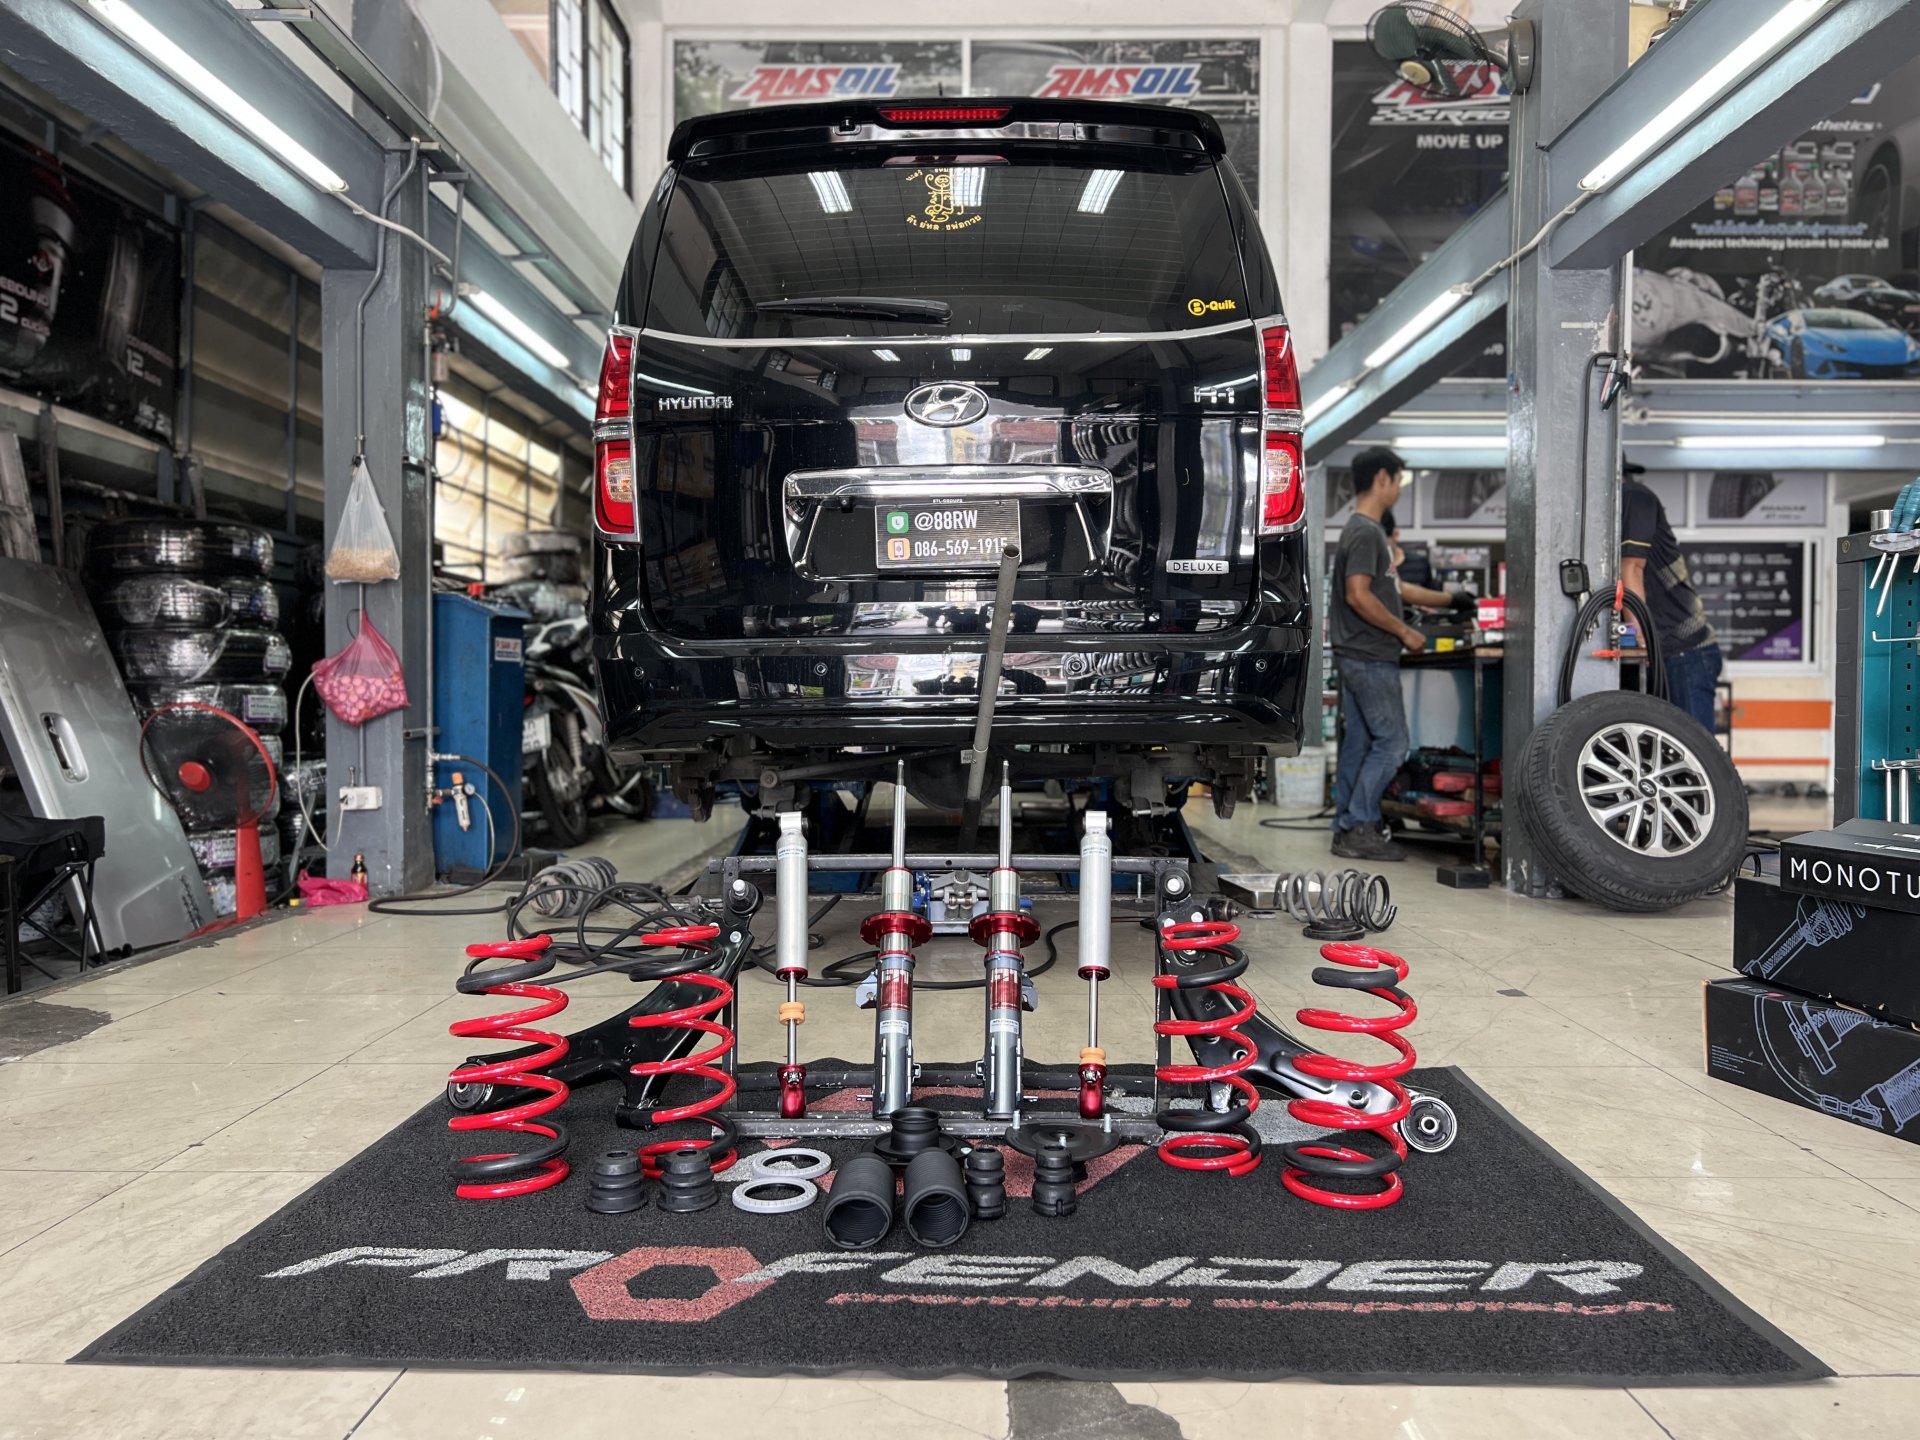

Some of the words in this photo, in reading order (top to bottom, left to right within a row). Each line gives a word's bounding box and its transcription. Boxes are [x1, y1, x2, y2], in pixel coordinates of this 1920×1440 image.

[735, 65, 899, 105] AMSOIL
[1034, 65, 1199, 101] AMSOIL
[1811, 120, 1875, 131] thetics
[1416, 133, 1471, 149] MOVE
[1475, 133, 1504, 149] UP
[1669, 236, 1724, 250] Aerospace
[1726, 237, 1785, 251] technology
[1786, 237, 1826, 249] became
[1828, 238, 1839, 249] to
[1841, 239, 1873, 249] motor
[1874, 238, 1889, 249] oil
[127, 349, 144, 377] 12
[658, 396, 732, 411] HYUNDAI
[1194, 386, 1235, 404] H-1
[914, 510, 978, 531] @88RW
[1173, 562, 1223, 572] DELUXE
